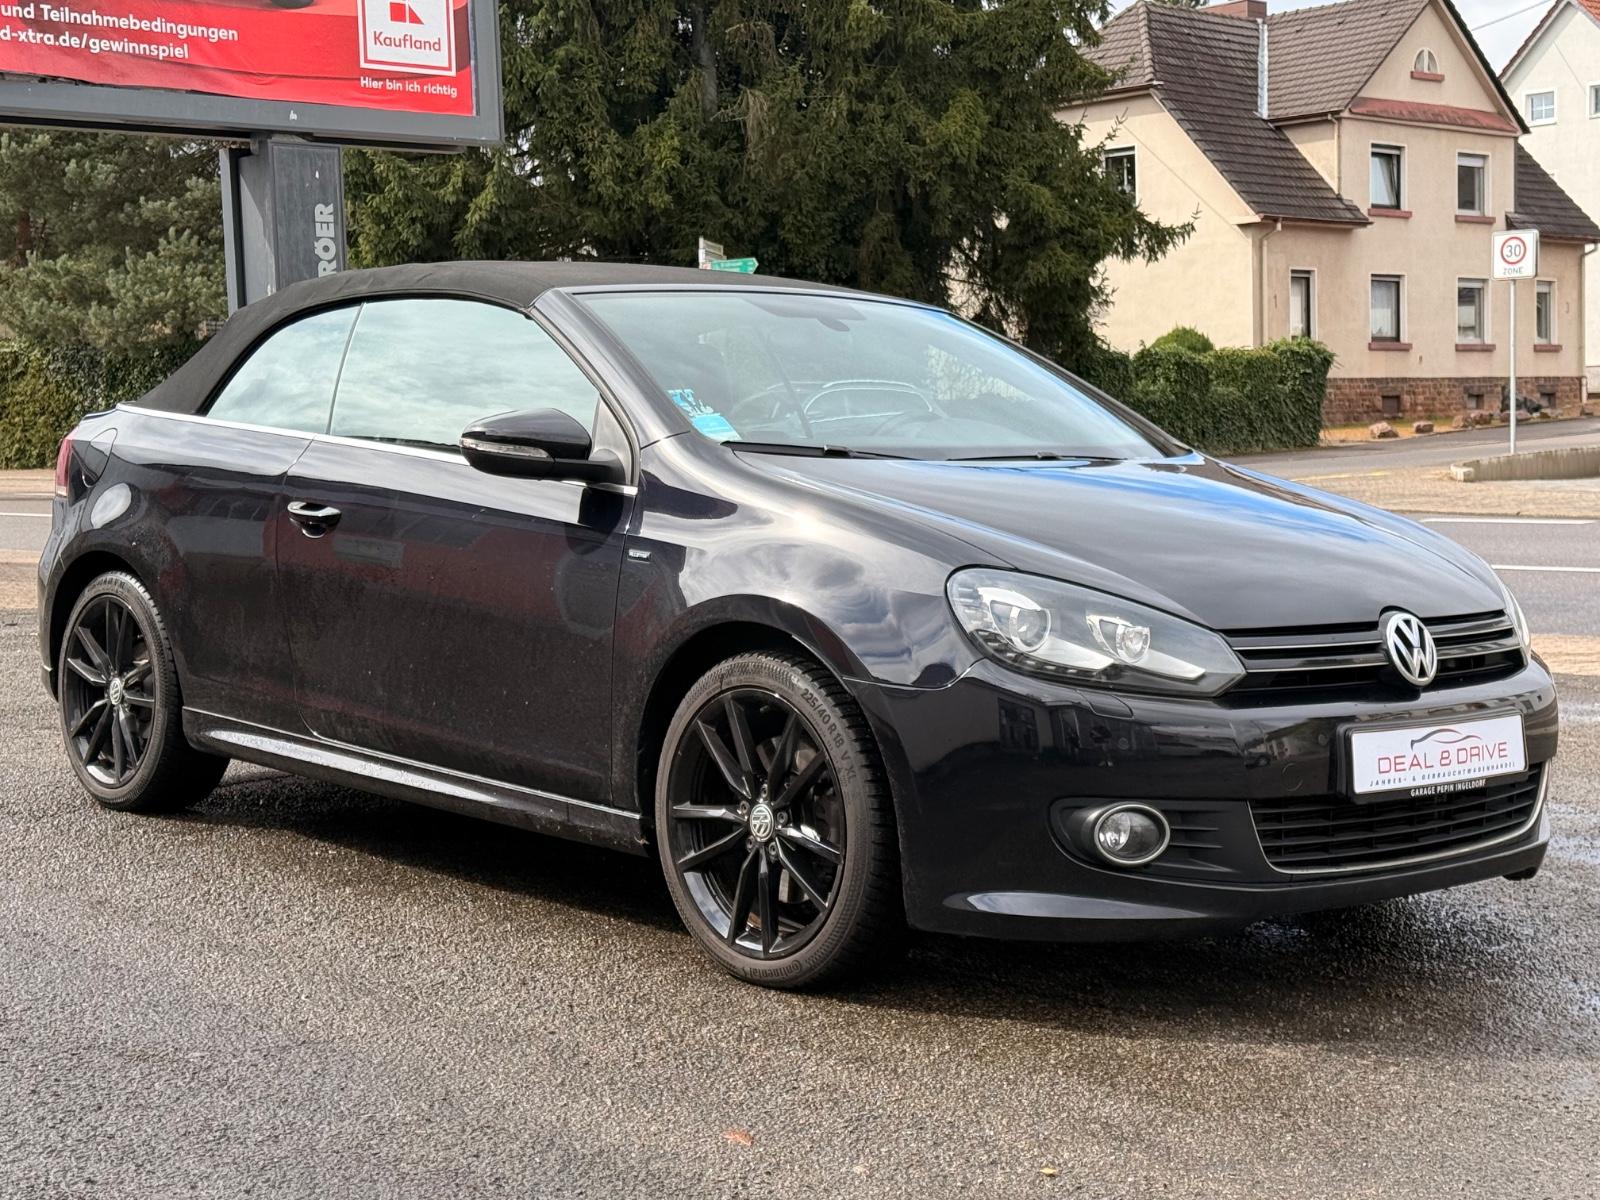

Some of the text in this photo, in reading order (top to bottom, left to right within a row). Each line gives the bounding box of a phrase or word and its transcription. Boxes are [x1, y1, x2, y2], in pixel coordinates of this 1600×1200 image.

[1, 4, 239, 42] und Teilnahmebedingungen
[0, 25, 189, 59] d-xtra.de/gewinnspiel
[373, 30, 441, 52] Kaufland
[360, 76, 457, 98] Hier bin ich richtig
[1506, 244, 1521, 258] 30
[1502, 266, 1524, 275] ZONE
[801, 688, 832, 725] 225/40
[1378, 752, 1433, 774] DEAL
[1456, 741, 1508, 765] DRIVE
[1410, 779, 1486, 797] GARAGE PEPIN INGELDORF
